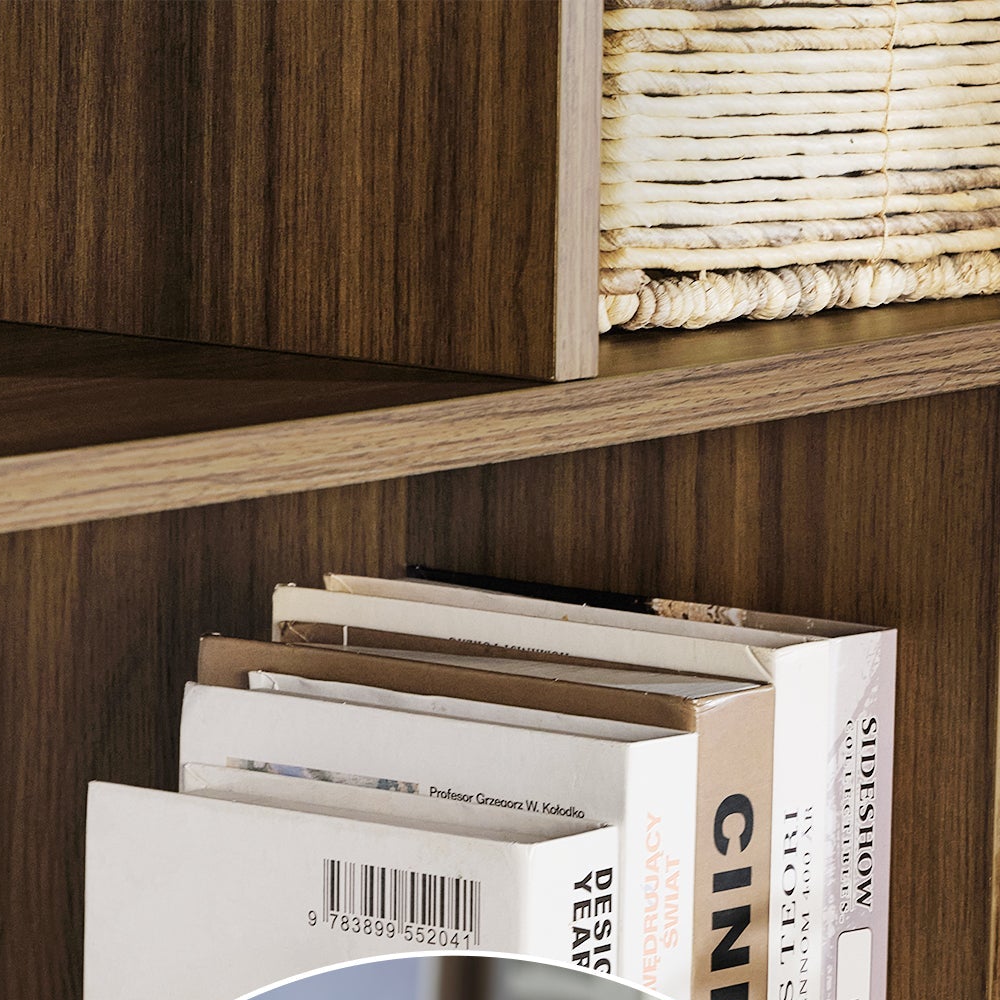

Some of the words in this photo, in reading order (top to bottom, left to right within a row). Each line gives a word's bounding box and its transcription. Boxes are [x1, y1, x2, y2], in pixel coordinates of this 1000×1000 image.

[430, 786, 473, 803] Profesor
[526, 799, 539, 813] W.
[543, 801, 585, 819] Kołodko
[841, 720, 854, 912] COLLECTIBLES
[856, 717, 878, 907] SIDESHOW
[308, 910, 317, 927] 9
[330, 913, 396, 939] 783899
[404, 925, 470, 950] 552041
[662, 855, 681, 949] ŚWIAT
[780, 808, 798, 965] TEORI
